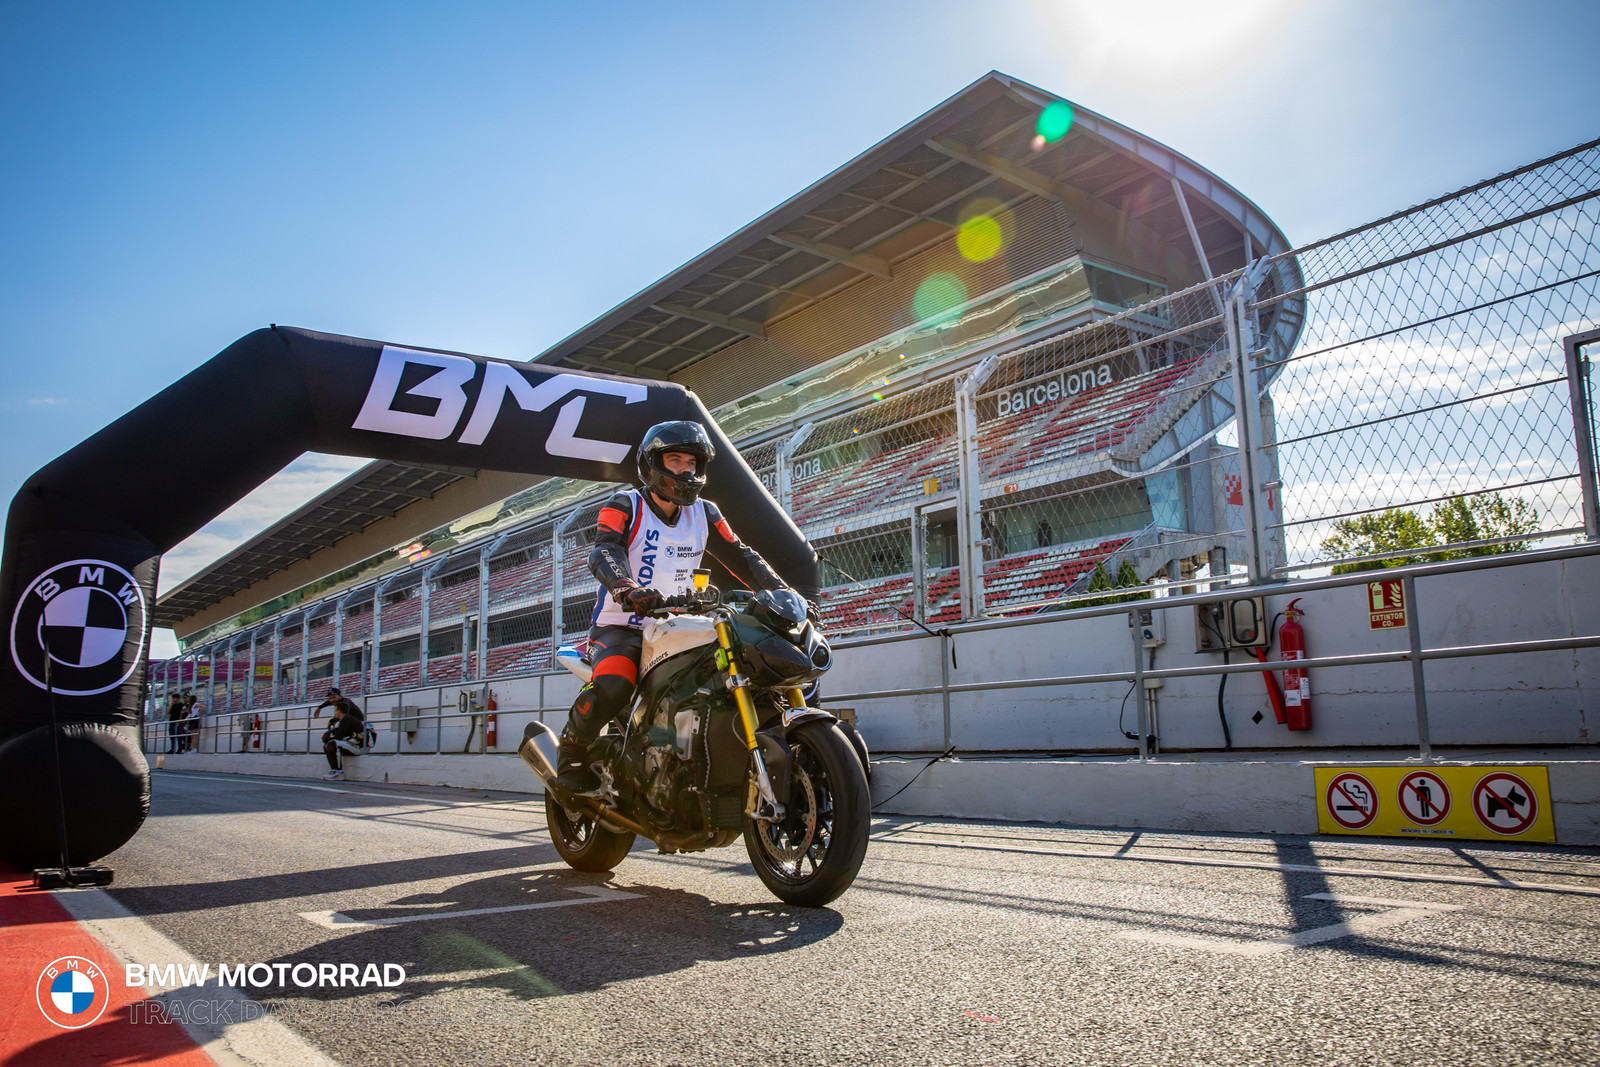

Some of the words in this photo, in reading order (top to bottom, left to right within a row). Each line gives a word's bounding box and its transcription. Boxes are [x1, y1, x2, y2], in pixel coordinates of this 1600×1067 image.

[352, 345, 647, 465] BMC
[997, 364, 1113, 417] Barcelona
[34, 566, 139, 607] BMW
[1372, 612, 1403, 622] EXTINTOR
